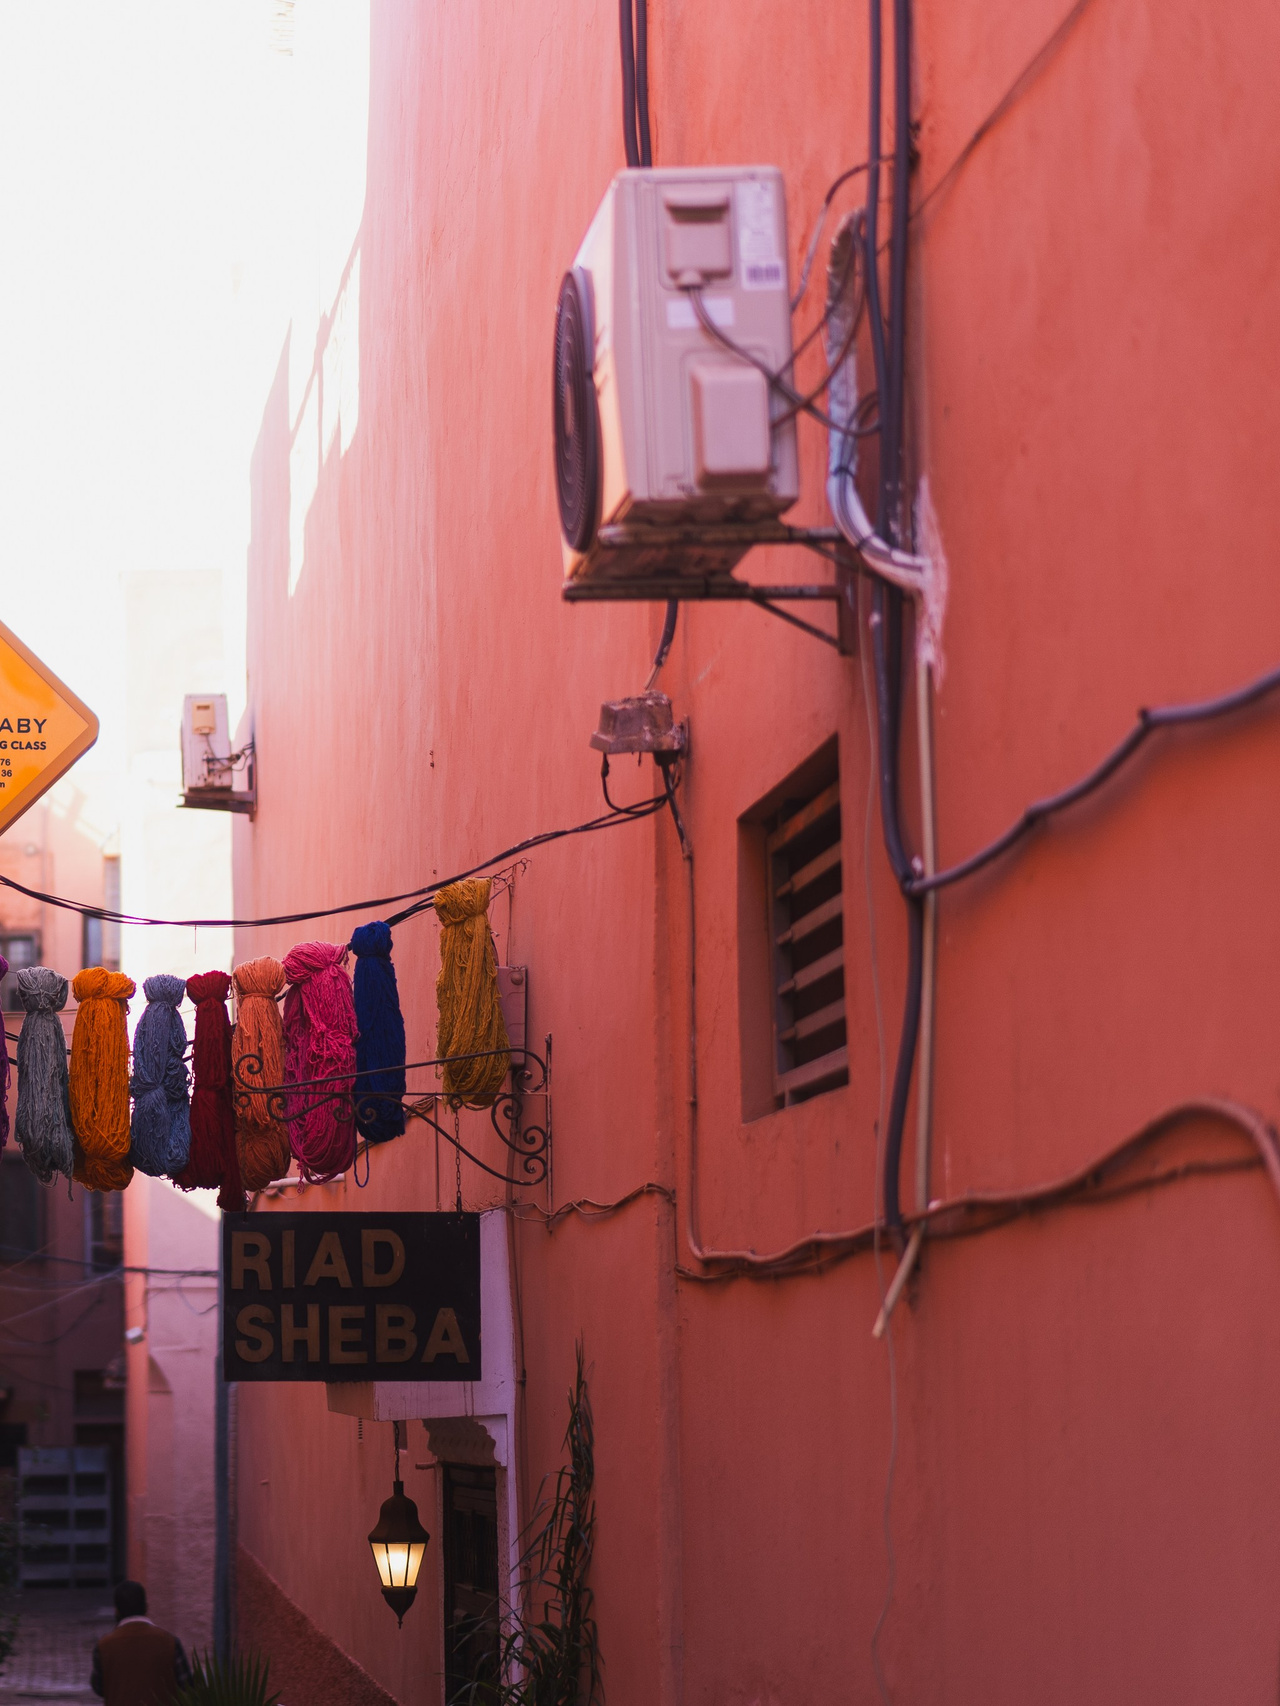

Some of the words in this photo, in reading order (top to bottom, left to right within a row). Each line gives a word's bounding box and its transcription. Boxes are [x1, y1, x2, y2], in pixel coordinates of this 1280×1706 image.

[11, 741, 47, 750] CLASS
[0, 758, 11, 766] 76
[1, 769, 13, 777] 36
[231, 1229, 406, 1290] RIAD
[235, 1303, 470, 1364] SHEBA
